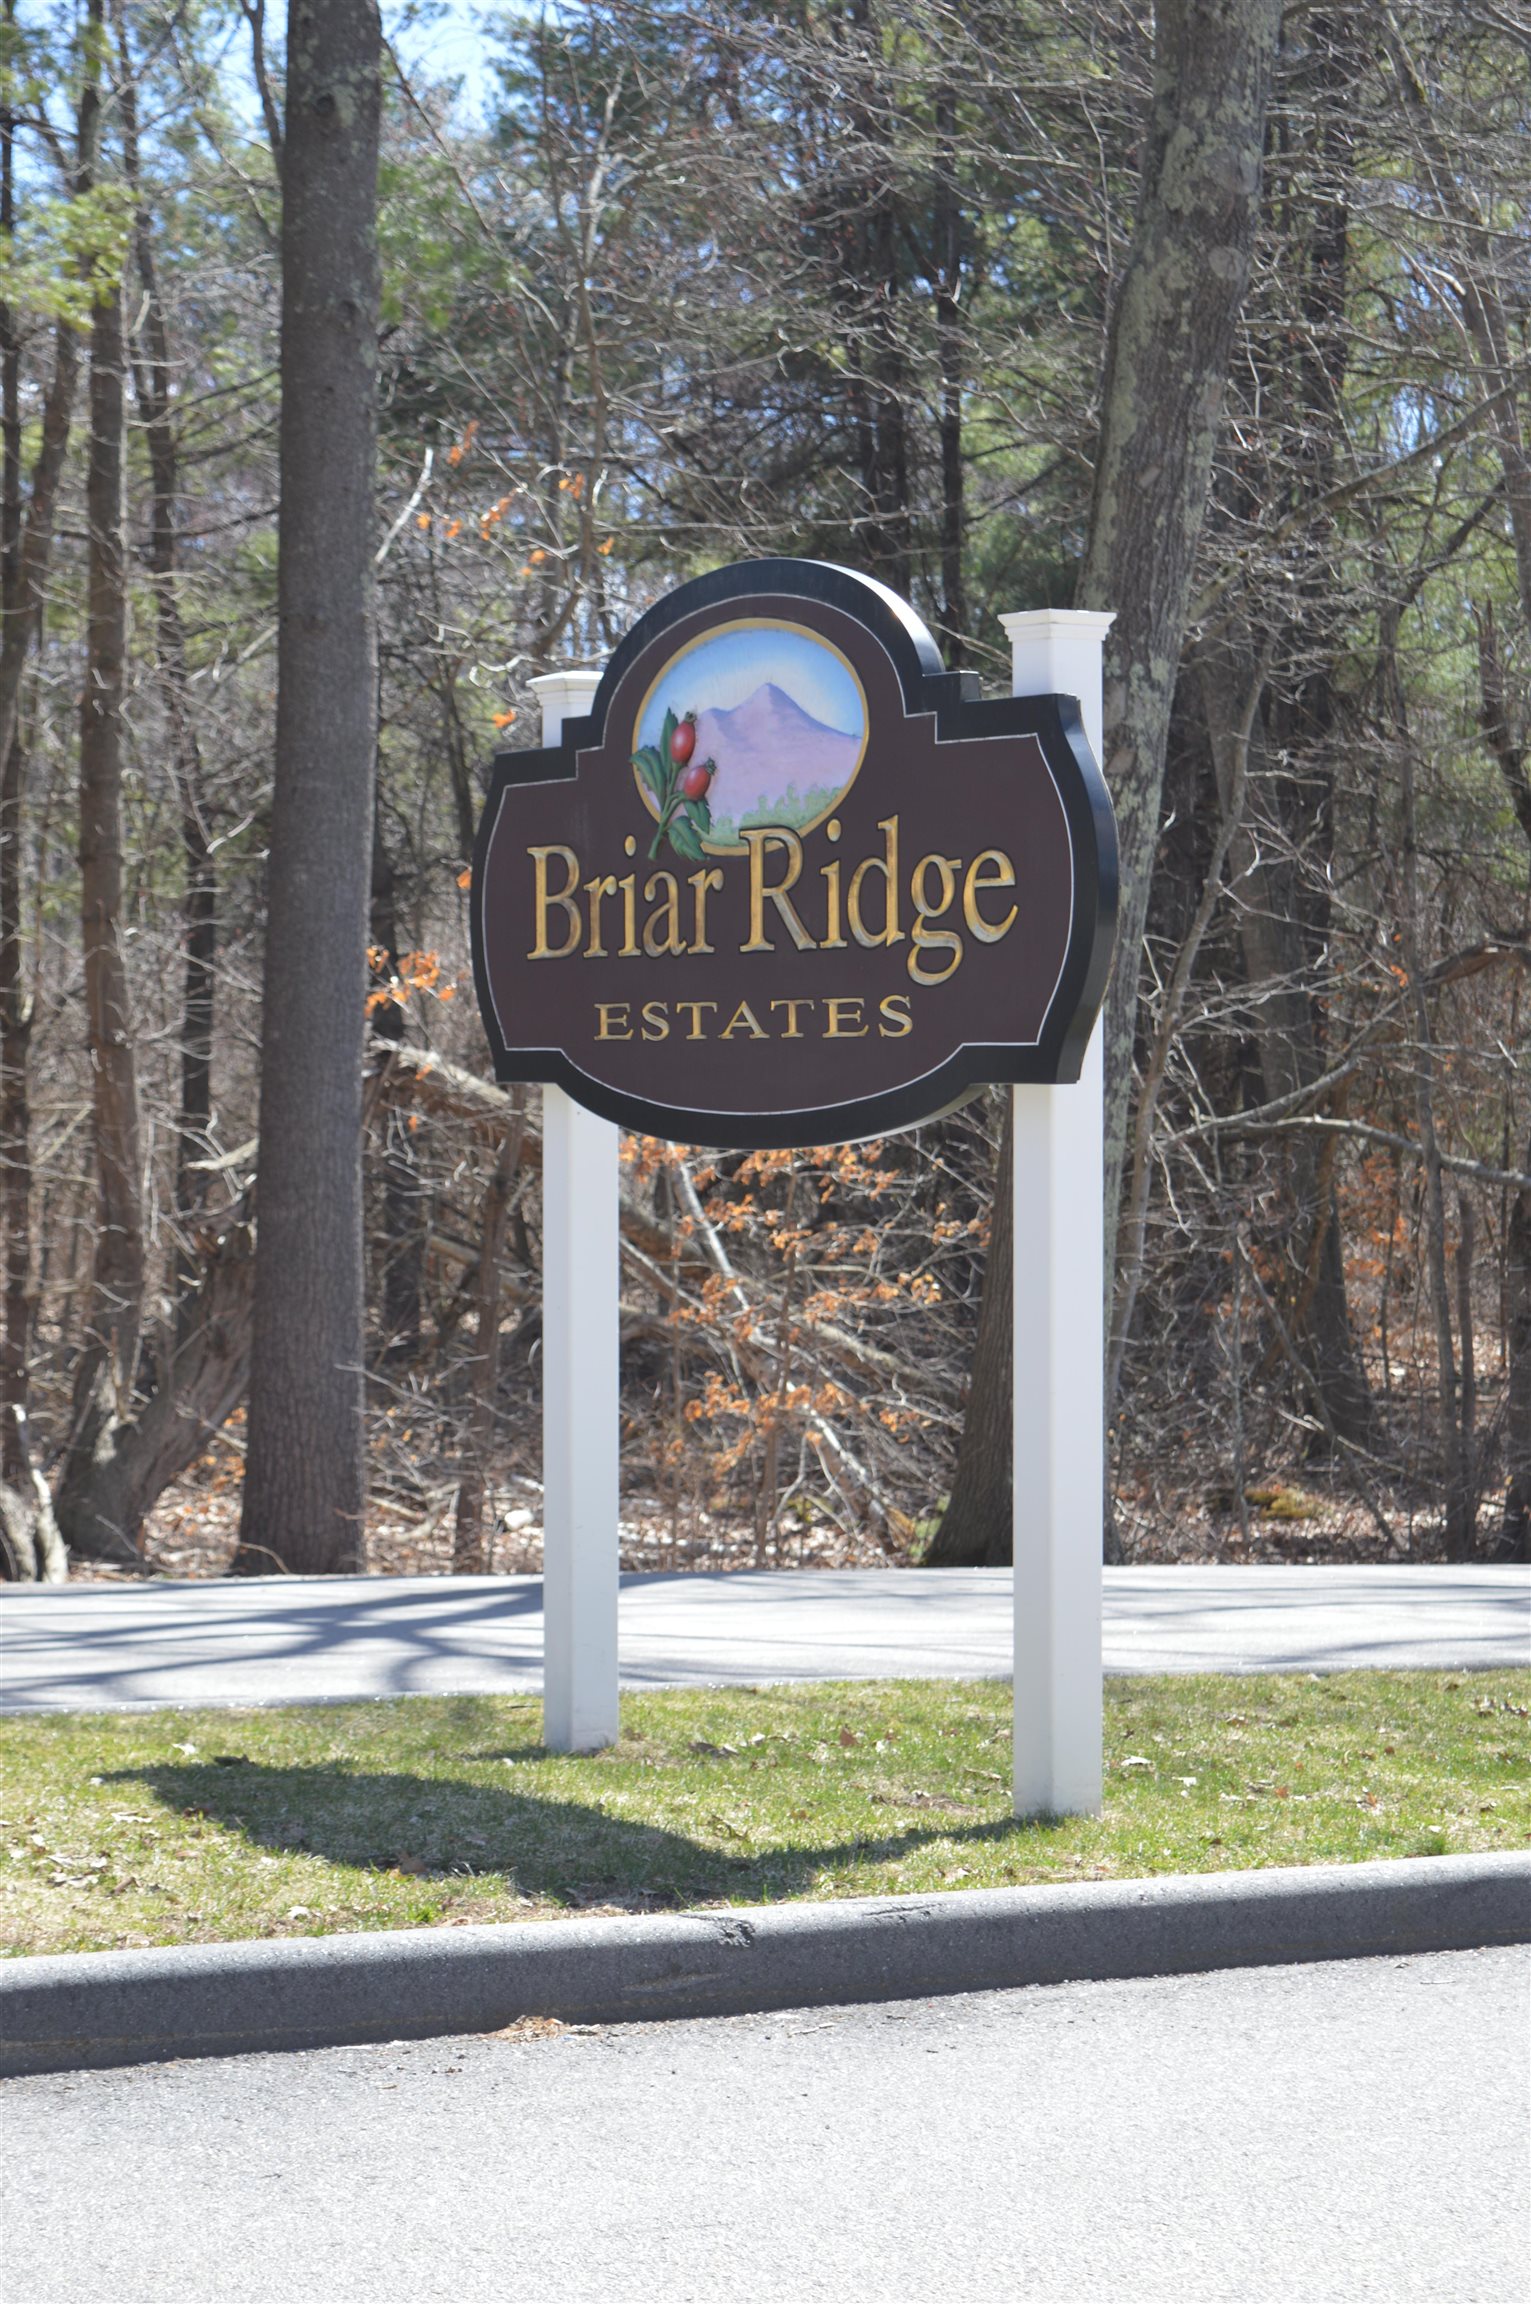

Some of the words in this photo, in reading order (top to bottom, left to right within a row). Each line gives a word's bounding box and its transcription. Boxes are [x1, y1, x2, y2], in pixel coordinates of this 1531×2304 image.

[526, 834, 724, 960] Briar
[739, 814, 1019, 986] Ridge
[593, 995, 914, 1041] ESTATES
